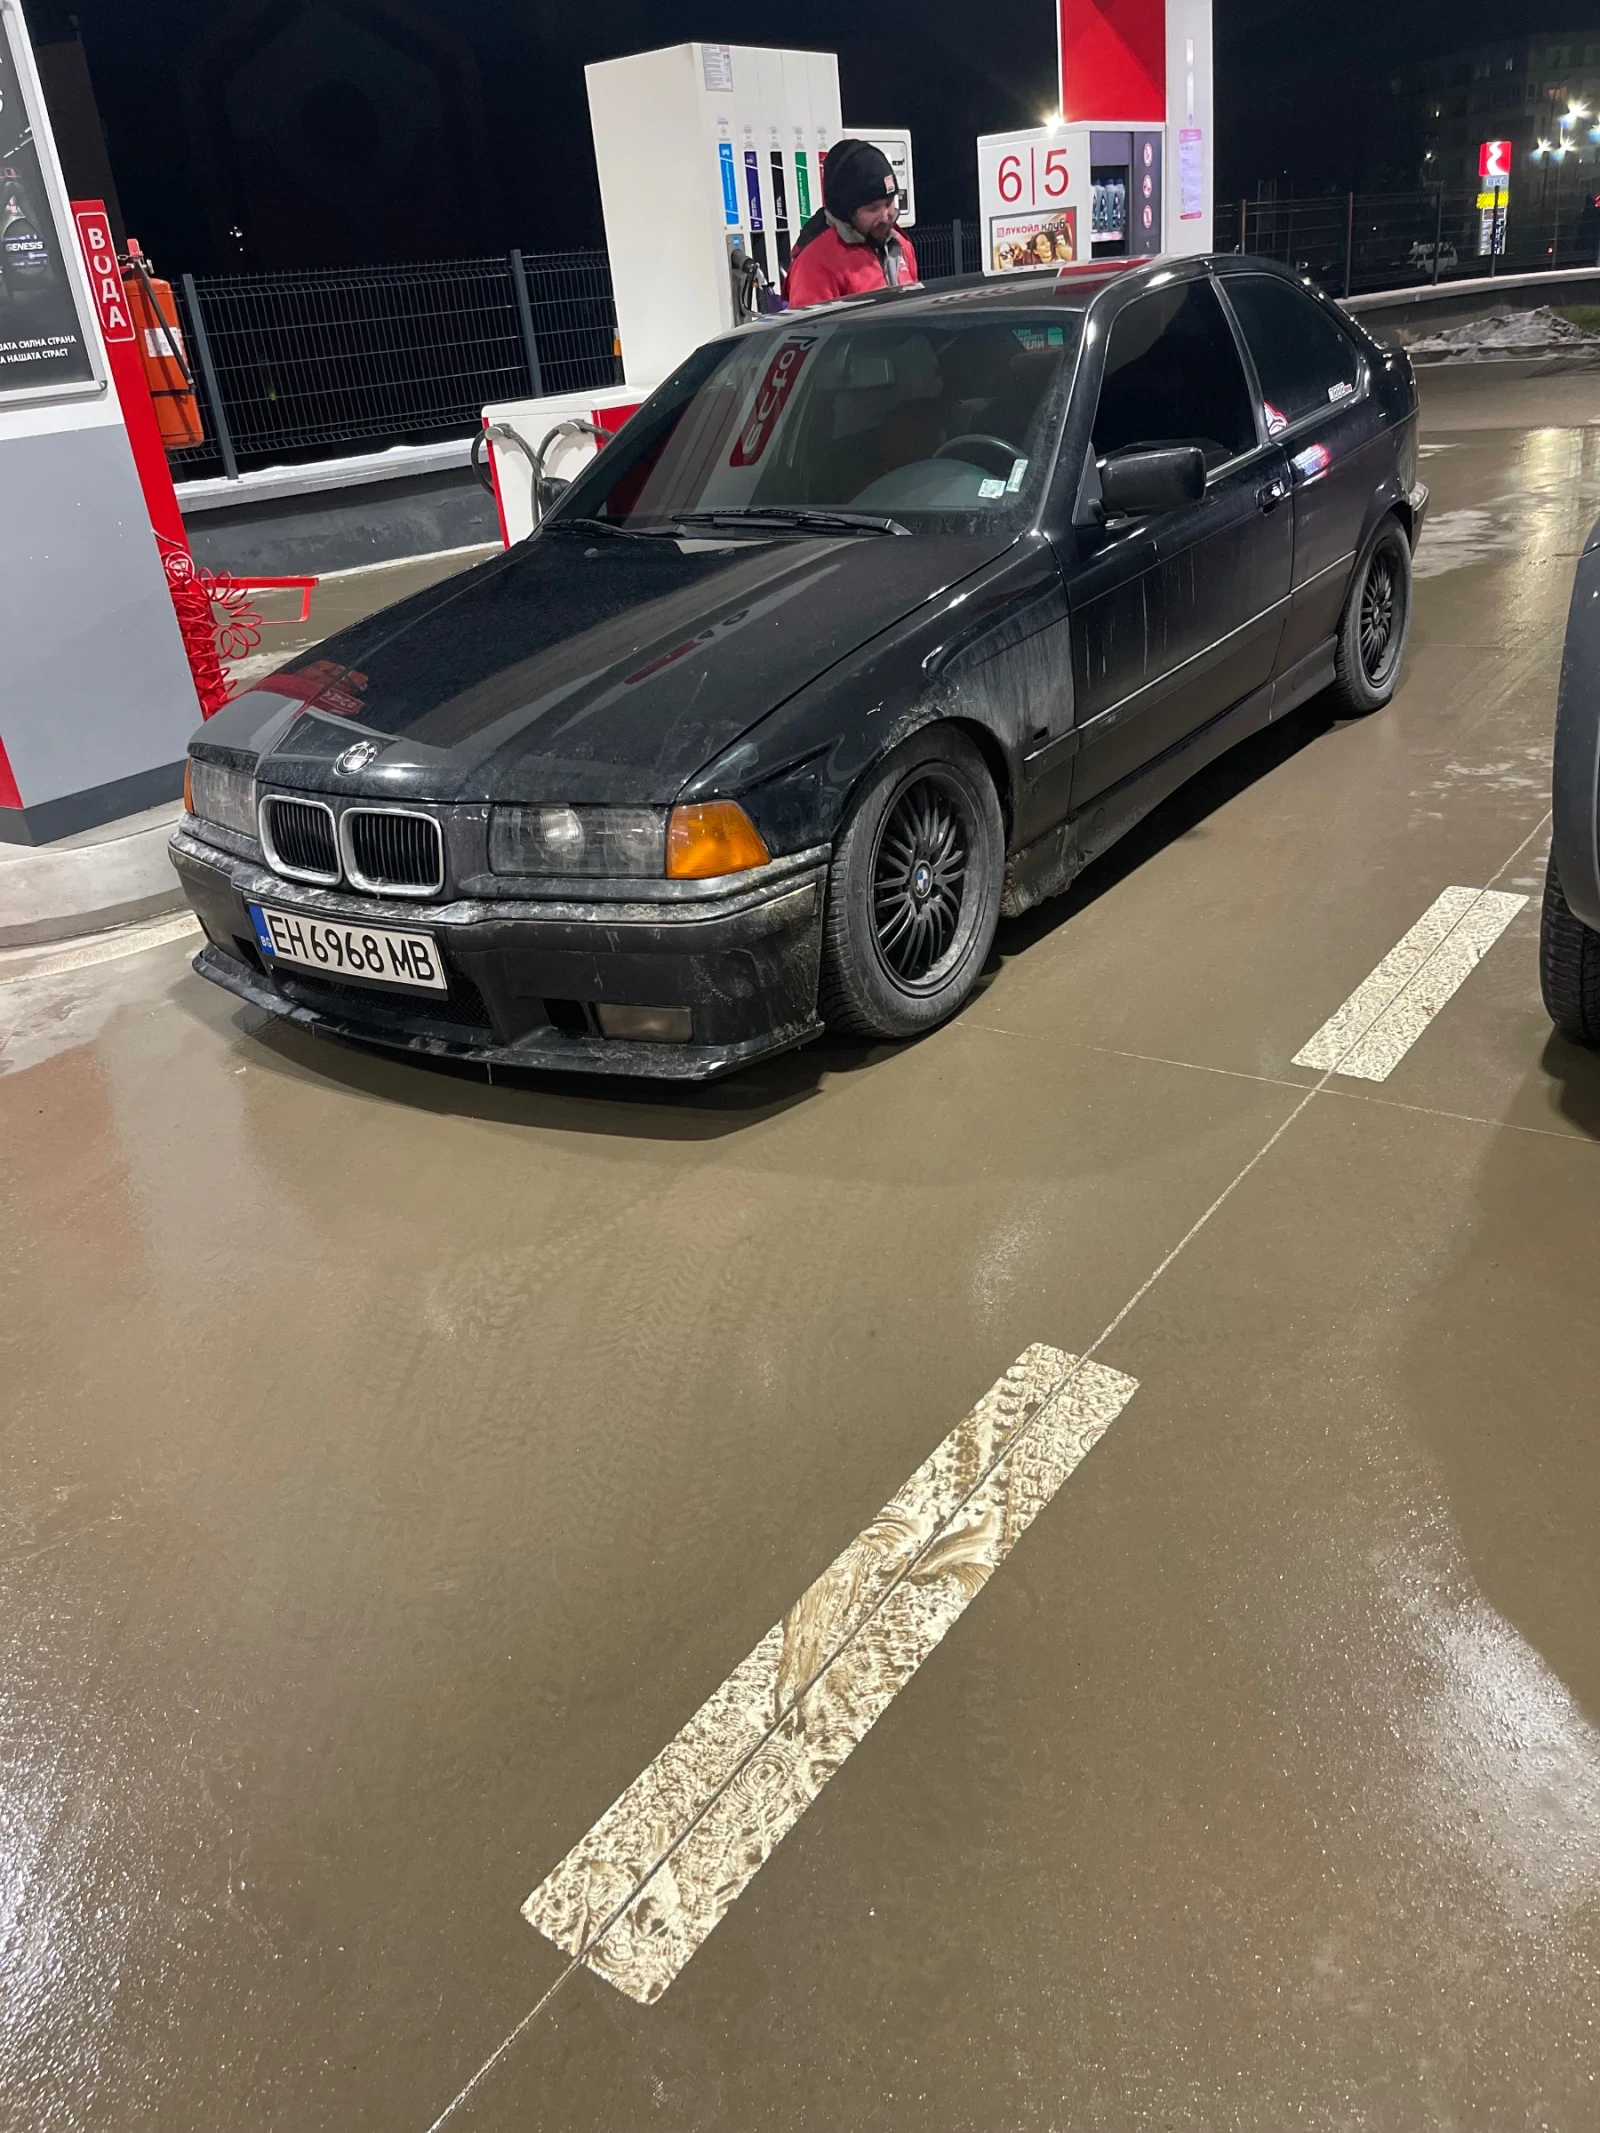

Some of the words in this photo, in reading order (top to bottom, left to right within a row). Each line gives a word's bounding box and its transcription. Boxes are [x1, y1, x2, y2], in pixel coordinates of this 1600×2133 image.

[998, 155, 1023, 203] 6
[1044, 148, 1069, 197] 5
[1005, 223, 1039, 235] ЛУКОЙЛ
[1041, 217, 1066, 233] клуб
[5, 241, 44, 251] GENESIS
[87, 228, 127, 329] ВОДА
[18, 338, 47, 349] СИЛНА
[47, 335, 77, 346] СТРАНА
[6, 351, 42, 363] НАШАТА
[42, 348, 69, 359] СТРАСТ
[260, 935, 273, 948] BG
[310, 925, 385, 973] 6968
